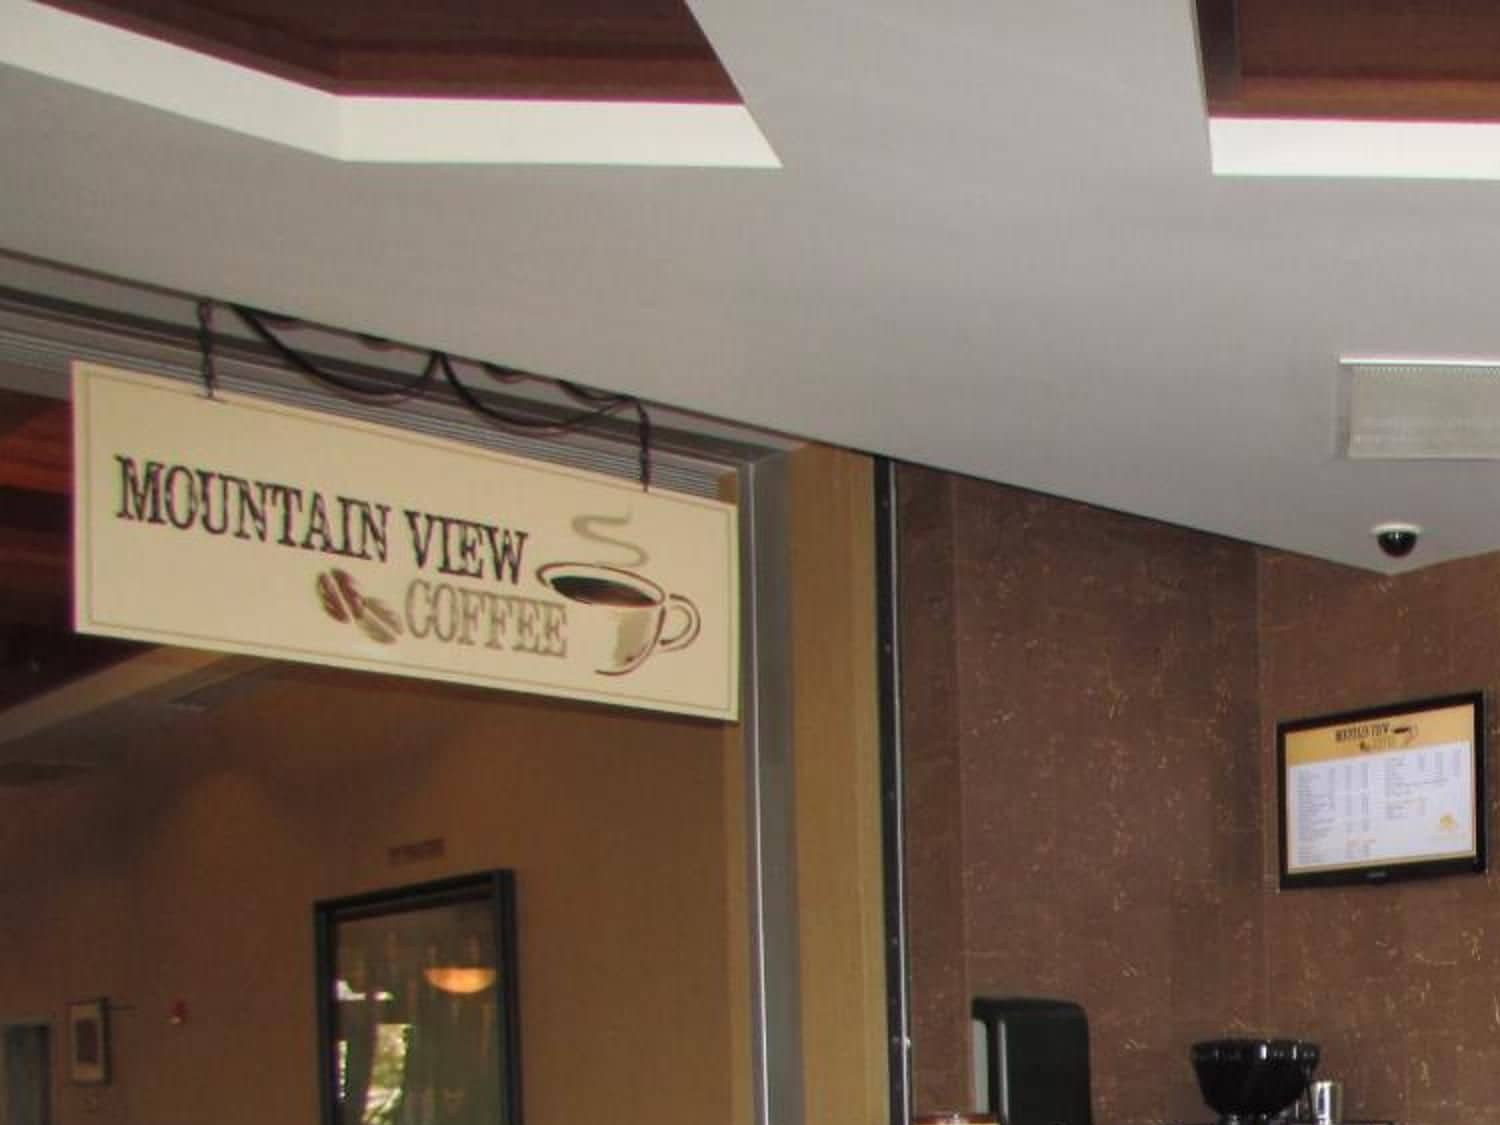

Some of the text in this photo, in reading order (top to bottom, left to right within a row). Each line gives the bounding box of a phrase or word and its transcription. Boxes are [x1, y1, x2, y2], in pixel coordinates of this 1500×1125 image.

[115, 455, 528, 585] MOUNTAIN VIEW
[405, 579, 568, 658] COFFEE
